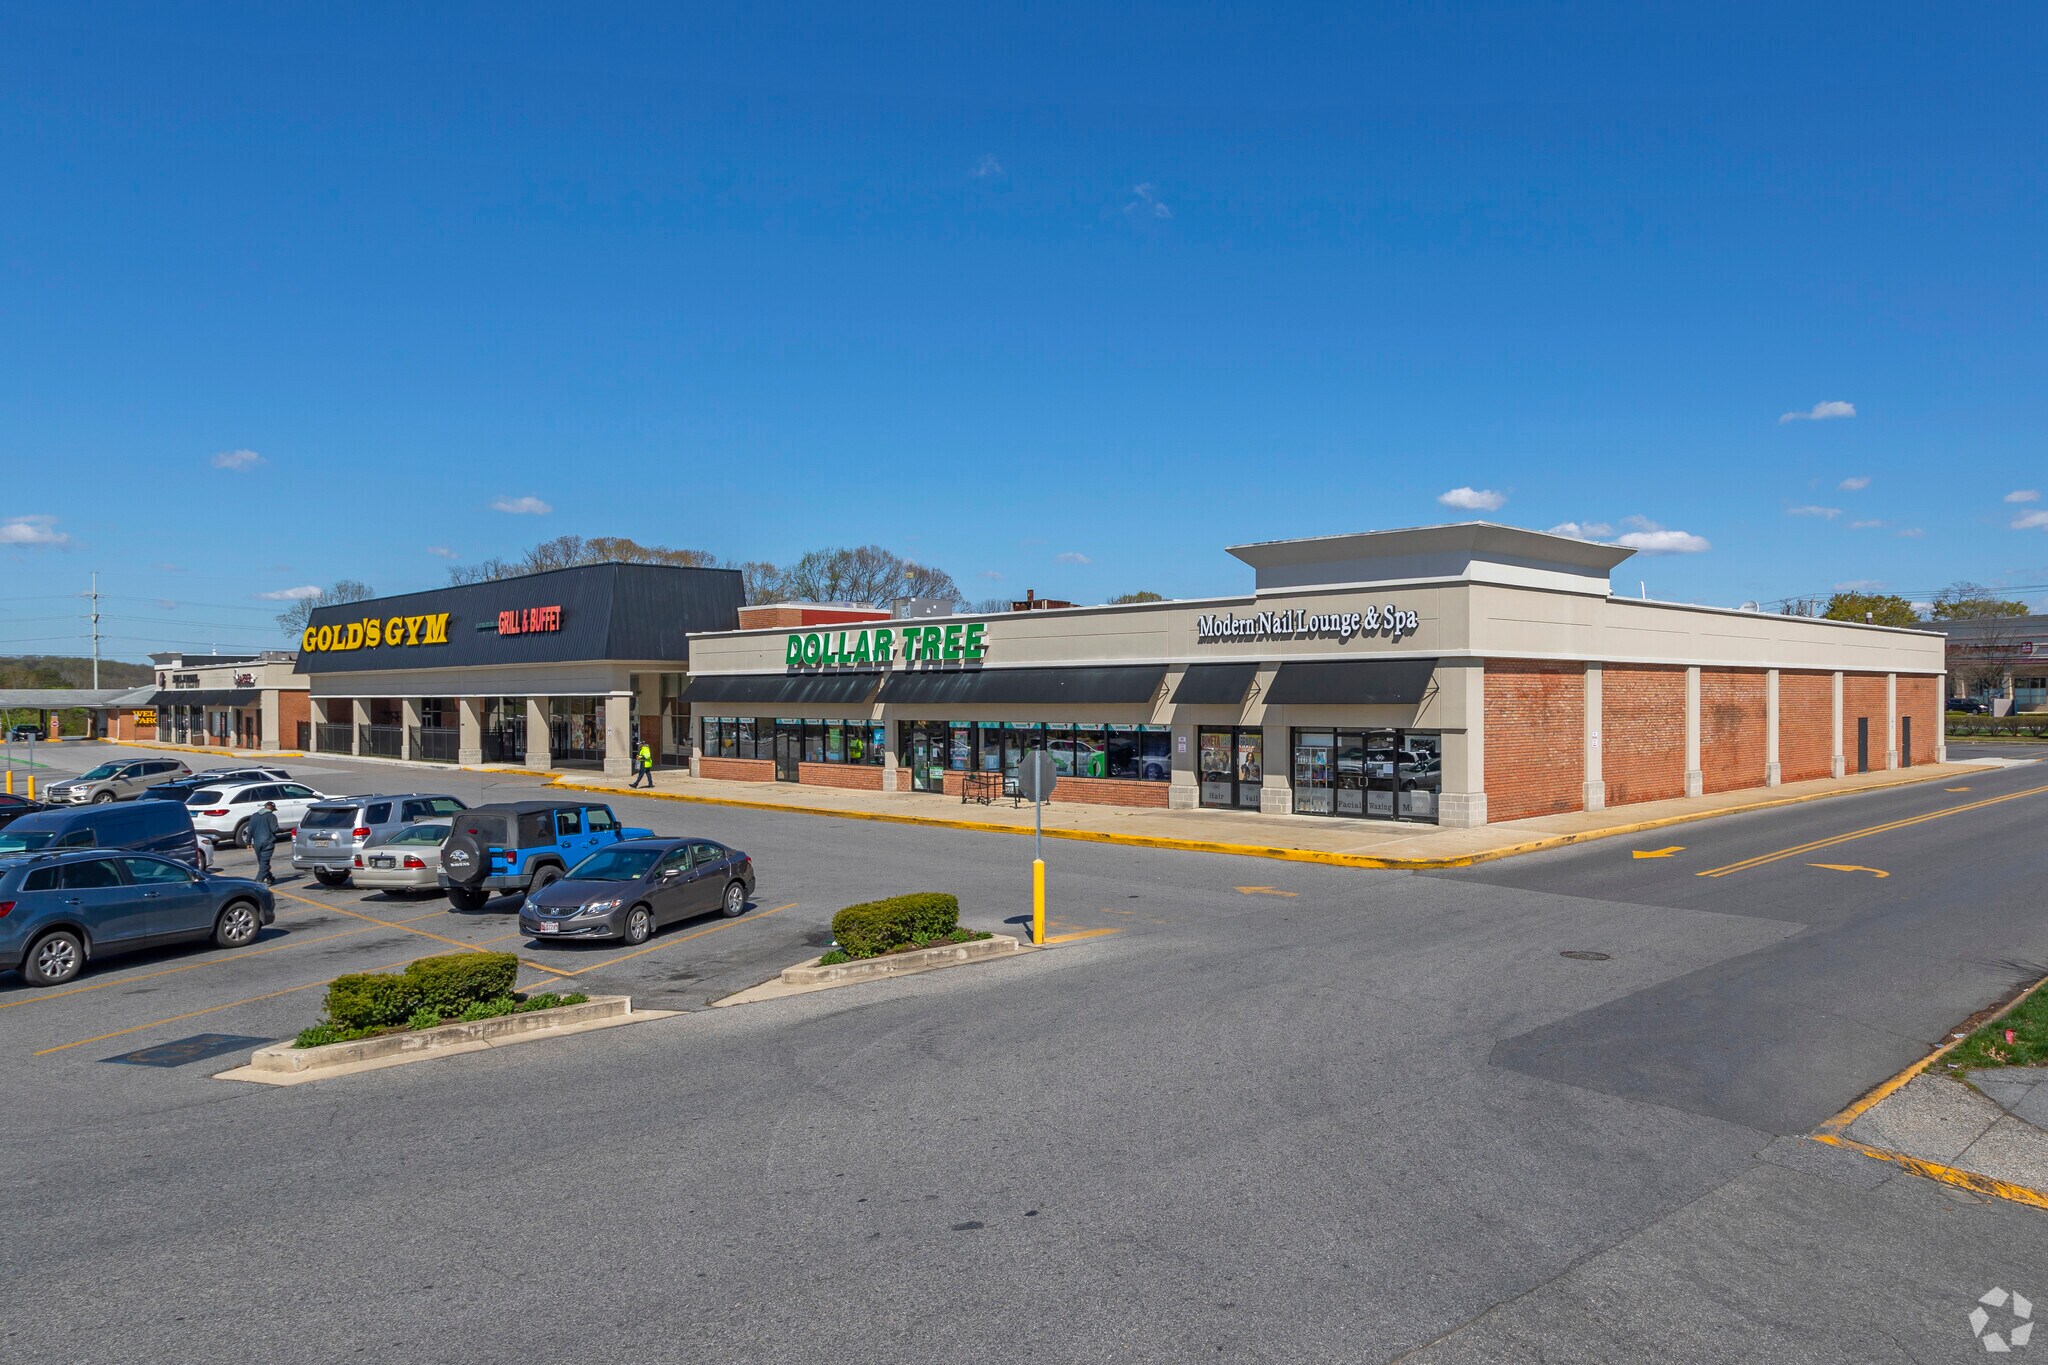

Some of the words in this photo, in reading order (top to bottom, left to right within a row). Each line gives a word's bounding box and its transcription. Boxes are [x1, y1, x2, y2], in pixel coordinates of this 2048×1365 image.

[302, 617, 382, 653] GOLD'S
[384, 612, 450, 647] GYM
[498, 609, 520, 635] GRILL
[521, 608, 529, 633] &
[529, 605, 561, 632] BUFFET
[1199, 612, 1256, 637] Modern
[1257, 609, 1294, 634] Nail
[1296, 609, 1361, 637] Lounge
[1363, 605, 1380, 630] &
[1383, 604, 1418, 636] Spa
[786, 628, 895, 665] DOLLAR
[902, 623, 988, 661] TREE
[1209, 792, 1225, 800] Hair
[1338, 800, 1362, 809] Facial
[1369, 801, 1392, 812] Waxing
